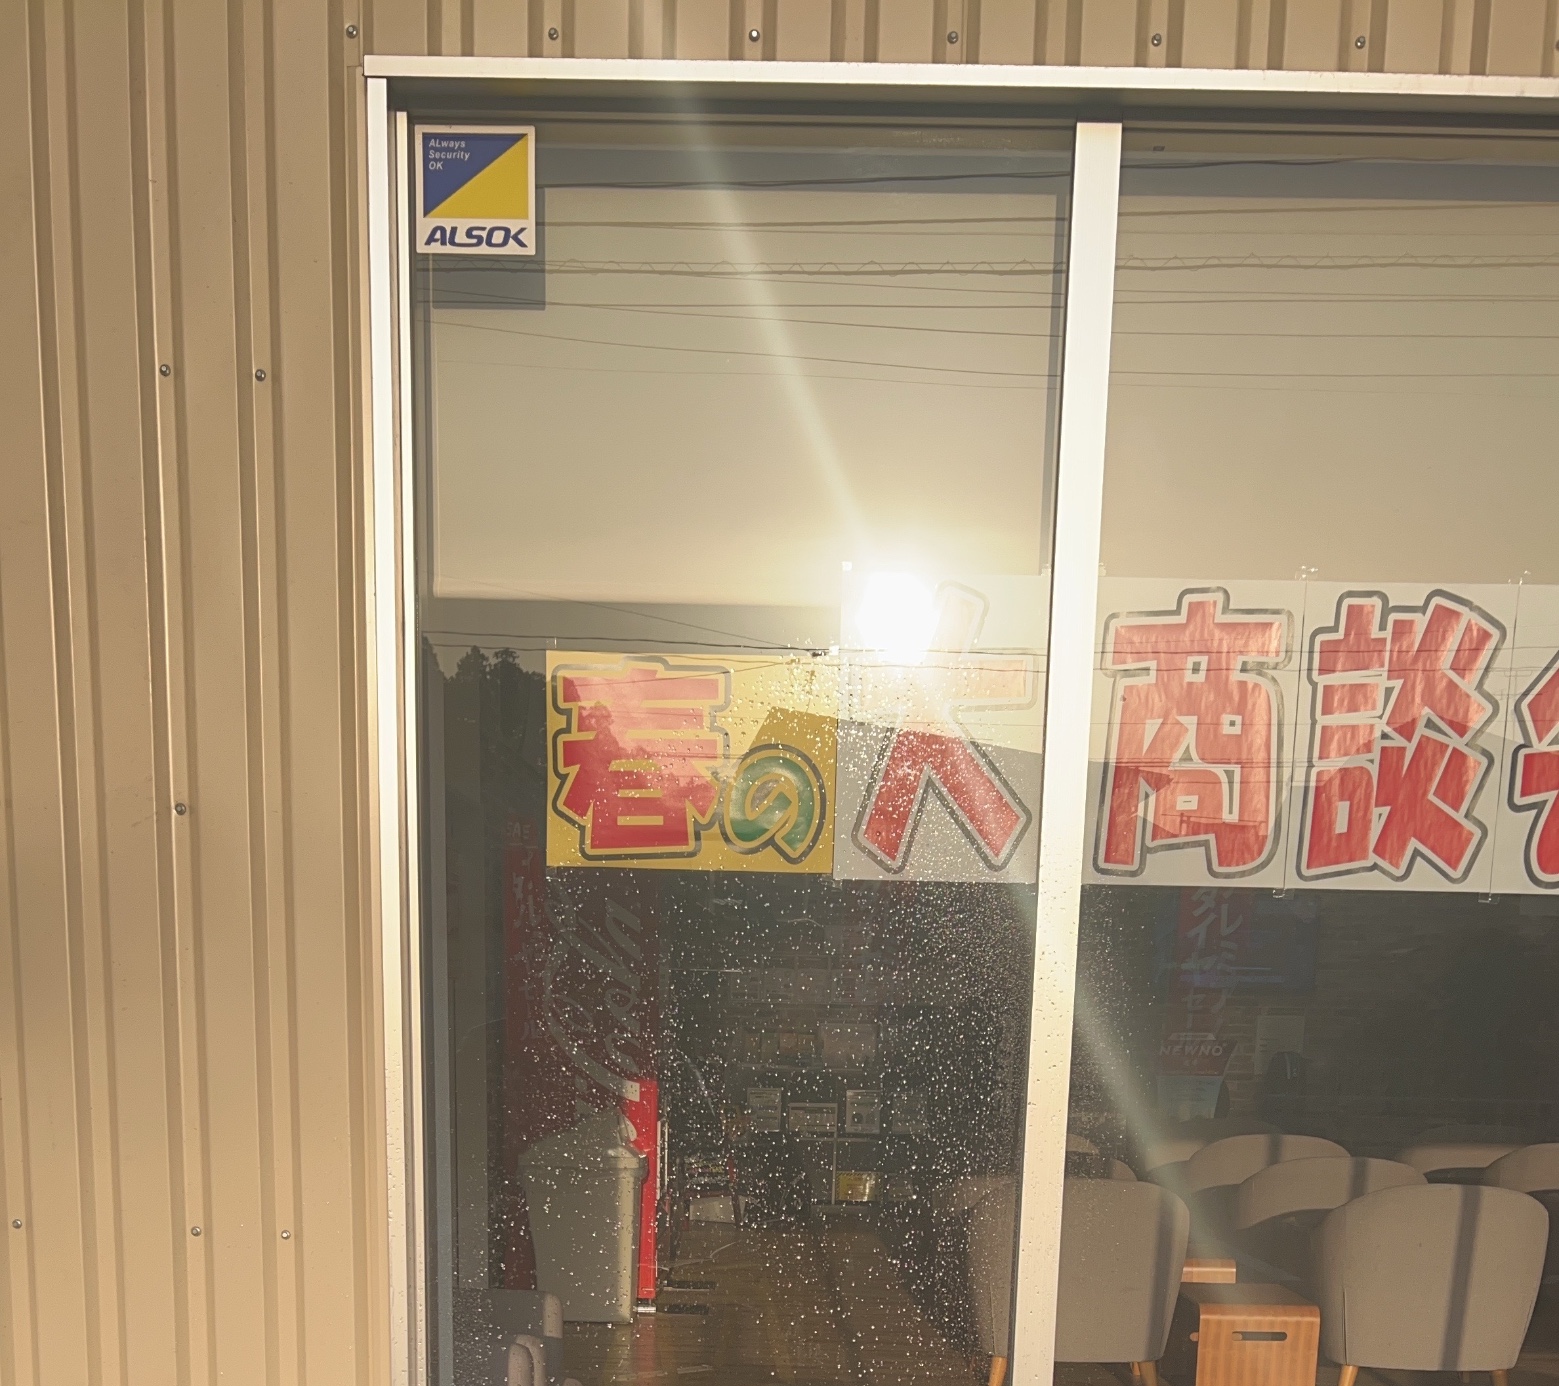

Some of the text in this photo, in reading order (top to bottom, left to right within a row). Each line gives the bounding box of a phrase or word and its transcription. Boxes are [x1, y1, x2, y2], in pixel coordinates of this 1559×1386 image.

[428, 138, 466, 149] ALways
[428, 149, 471, 161] Security
[428, 161, 444, 171] OK
[424, 225, 528, 249] ALSOK
